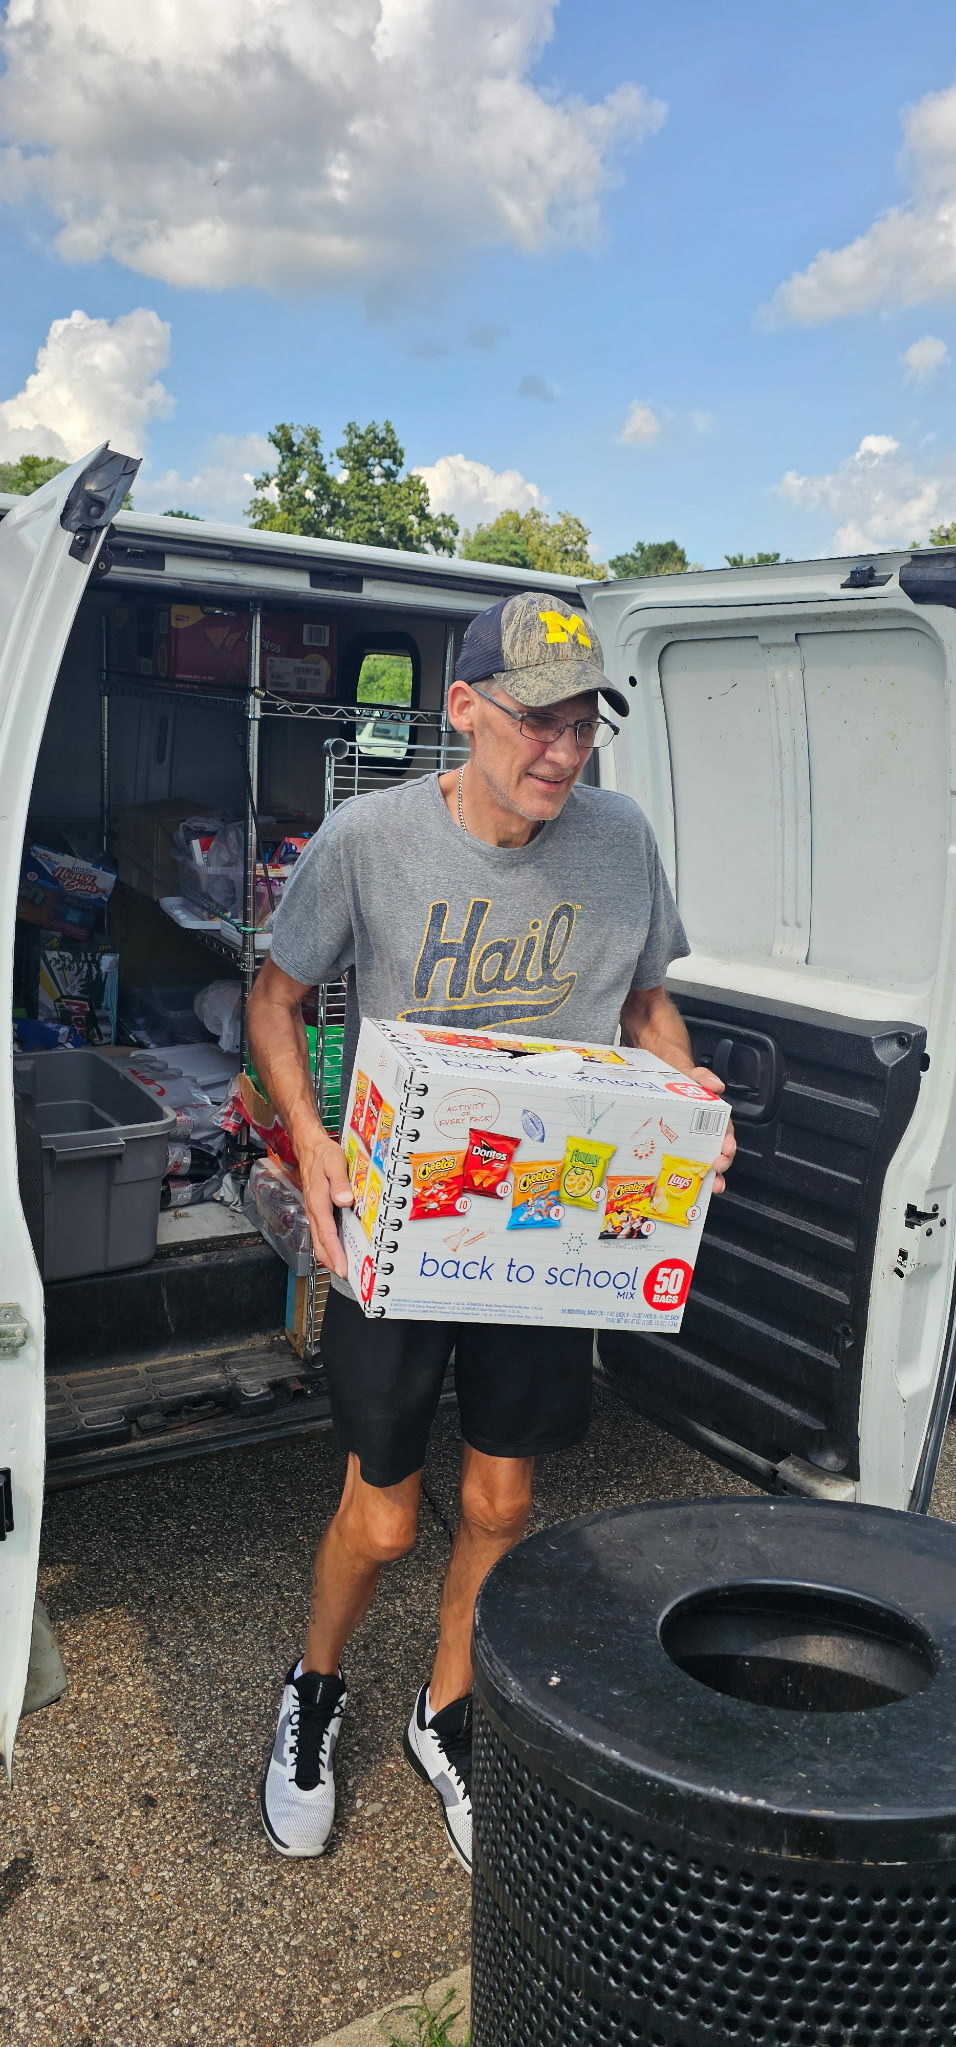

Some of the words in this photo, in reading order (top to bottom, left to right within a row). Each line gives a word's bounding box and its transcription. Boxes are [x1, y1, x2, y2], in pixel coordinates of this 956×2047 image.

[539, 610, 593, 648] M
[55, 867, 96, 884] Honey
[63, 879, 97, 892] Buns
[414, 899, 576, 1000] Hail
[441, 1058, 520, 1075] back
[673, 1084, 709, 1095] 50
[446, 1102, 486, 1113] ACTIVITY
[439, 1117, 466, 1127] EVERY
[472, 1145, 508, 1161] Doritos
[418, 1157, 457, 1181] Cheetos
[519, 1168, 557, 1192] Cheetos
[500, 1185, 509, 1194] 10
[595, 1190, 601, 1199] 8
[614, 1181, 646, 1199] Cheetos
[459, 1200, 468, 1209] 10
[554, 1208, 560, 1217] 8
[419, 1252, 495, 1281] back
[506, 1258, 535, 1283] to
[545, 1263, 639, 1291] school
[654, 1267, 685, 1295] 50
[616, 1291, 636, 1300] MIX
[652, 1295, 679, 1304] BAGS
